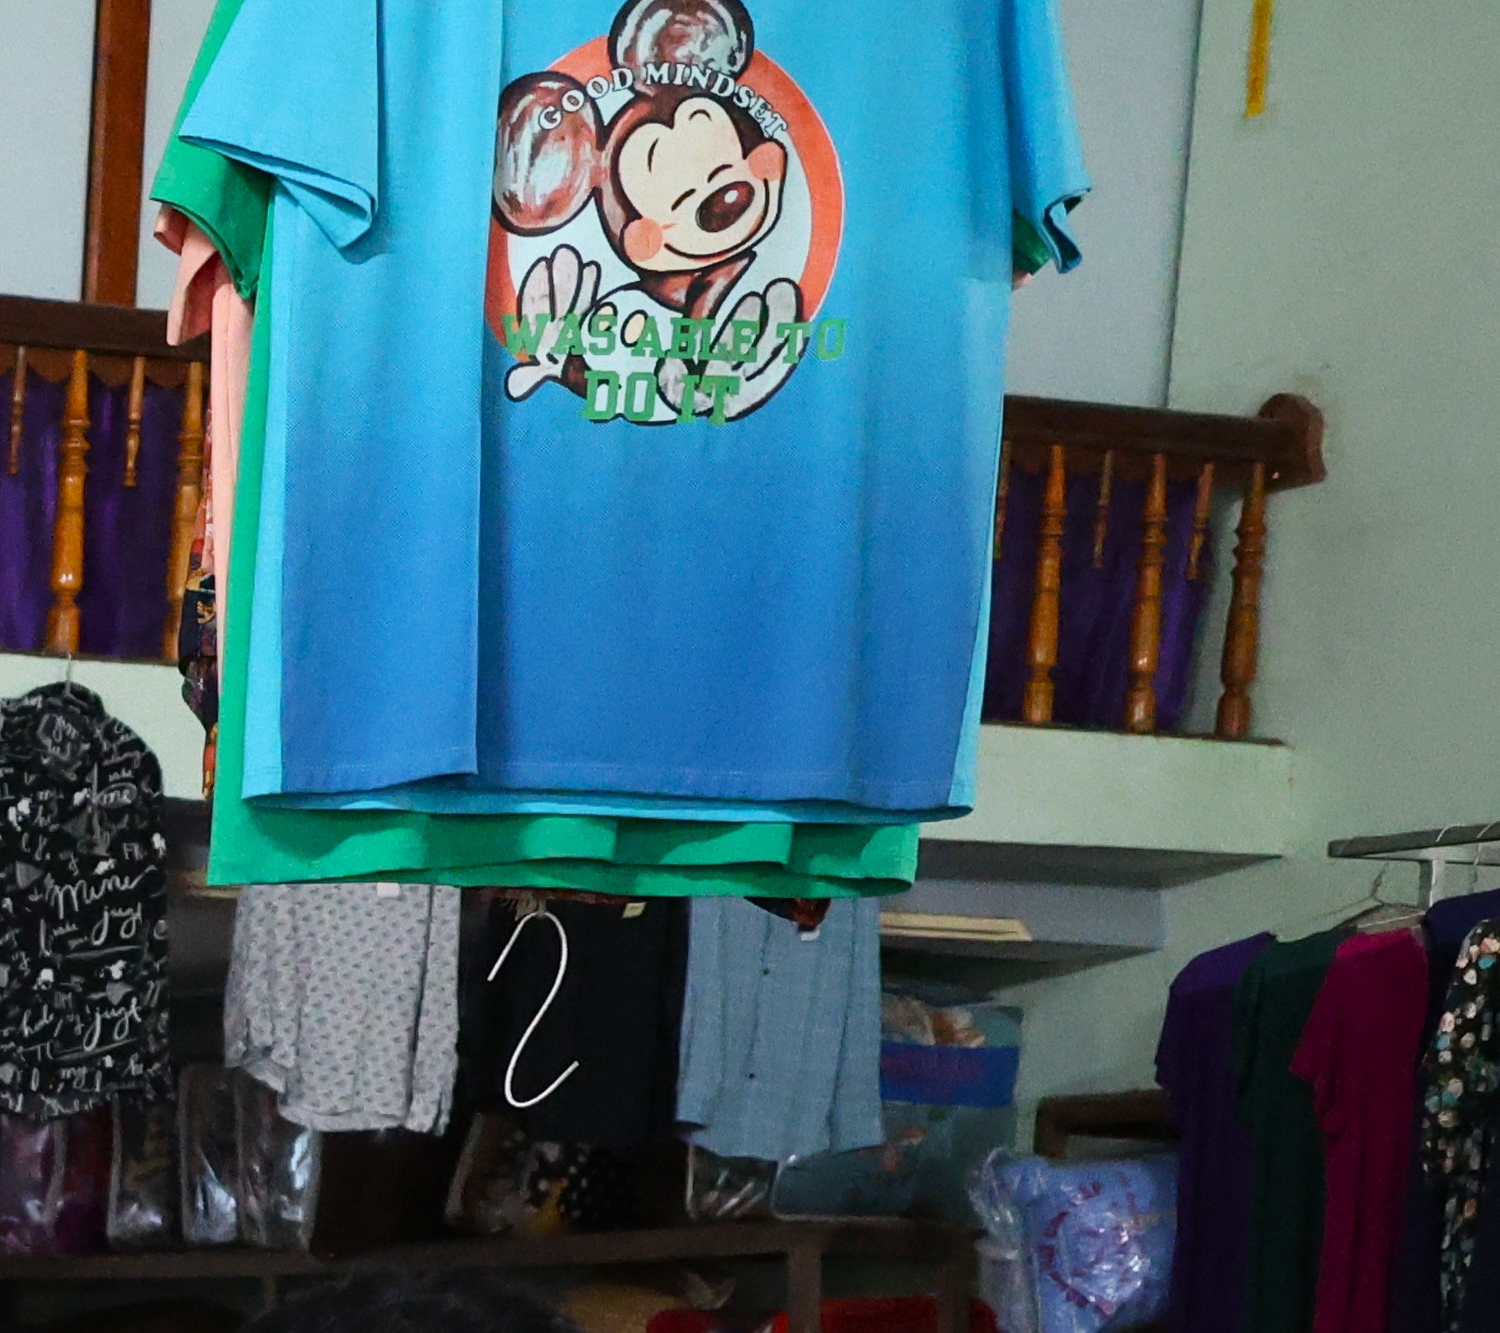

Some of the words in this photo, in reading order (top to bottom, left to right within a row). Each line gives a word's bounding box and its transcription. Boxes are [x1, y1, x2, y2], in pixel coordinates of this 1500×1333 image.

[537, 65, 635, 132] GOOD
[644, 60, 789, 138] MINDSET
[502, 314, 616, 359] WAS
[633, 314, 758, 364] ABLE
[780, 318, 846, 363] TO
[585, 371, 656, 423] DO
[677, 372, 739, 424] IT
